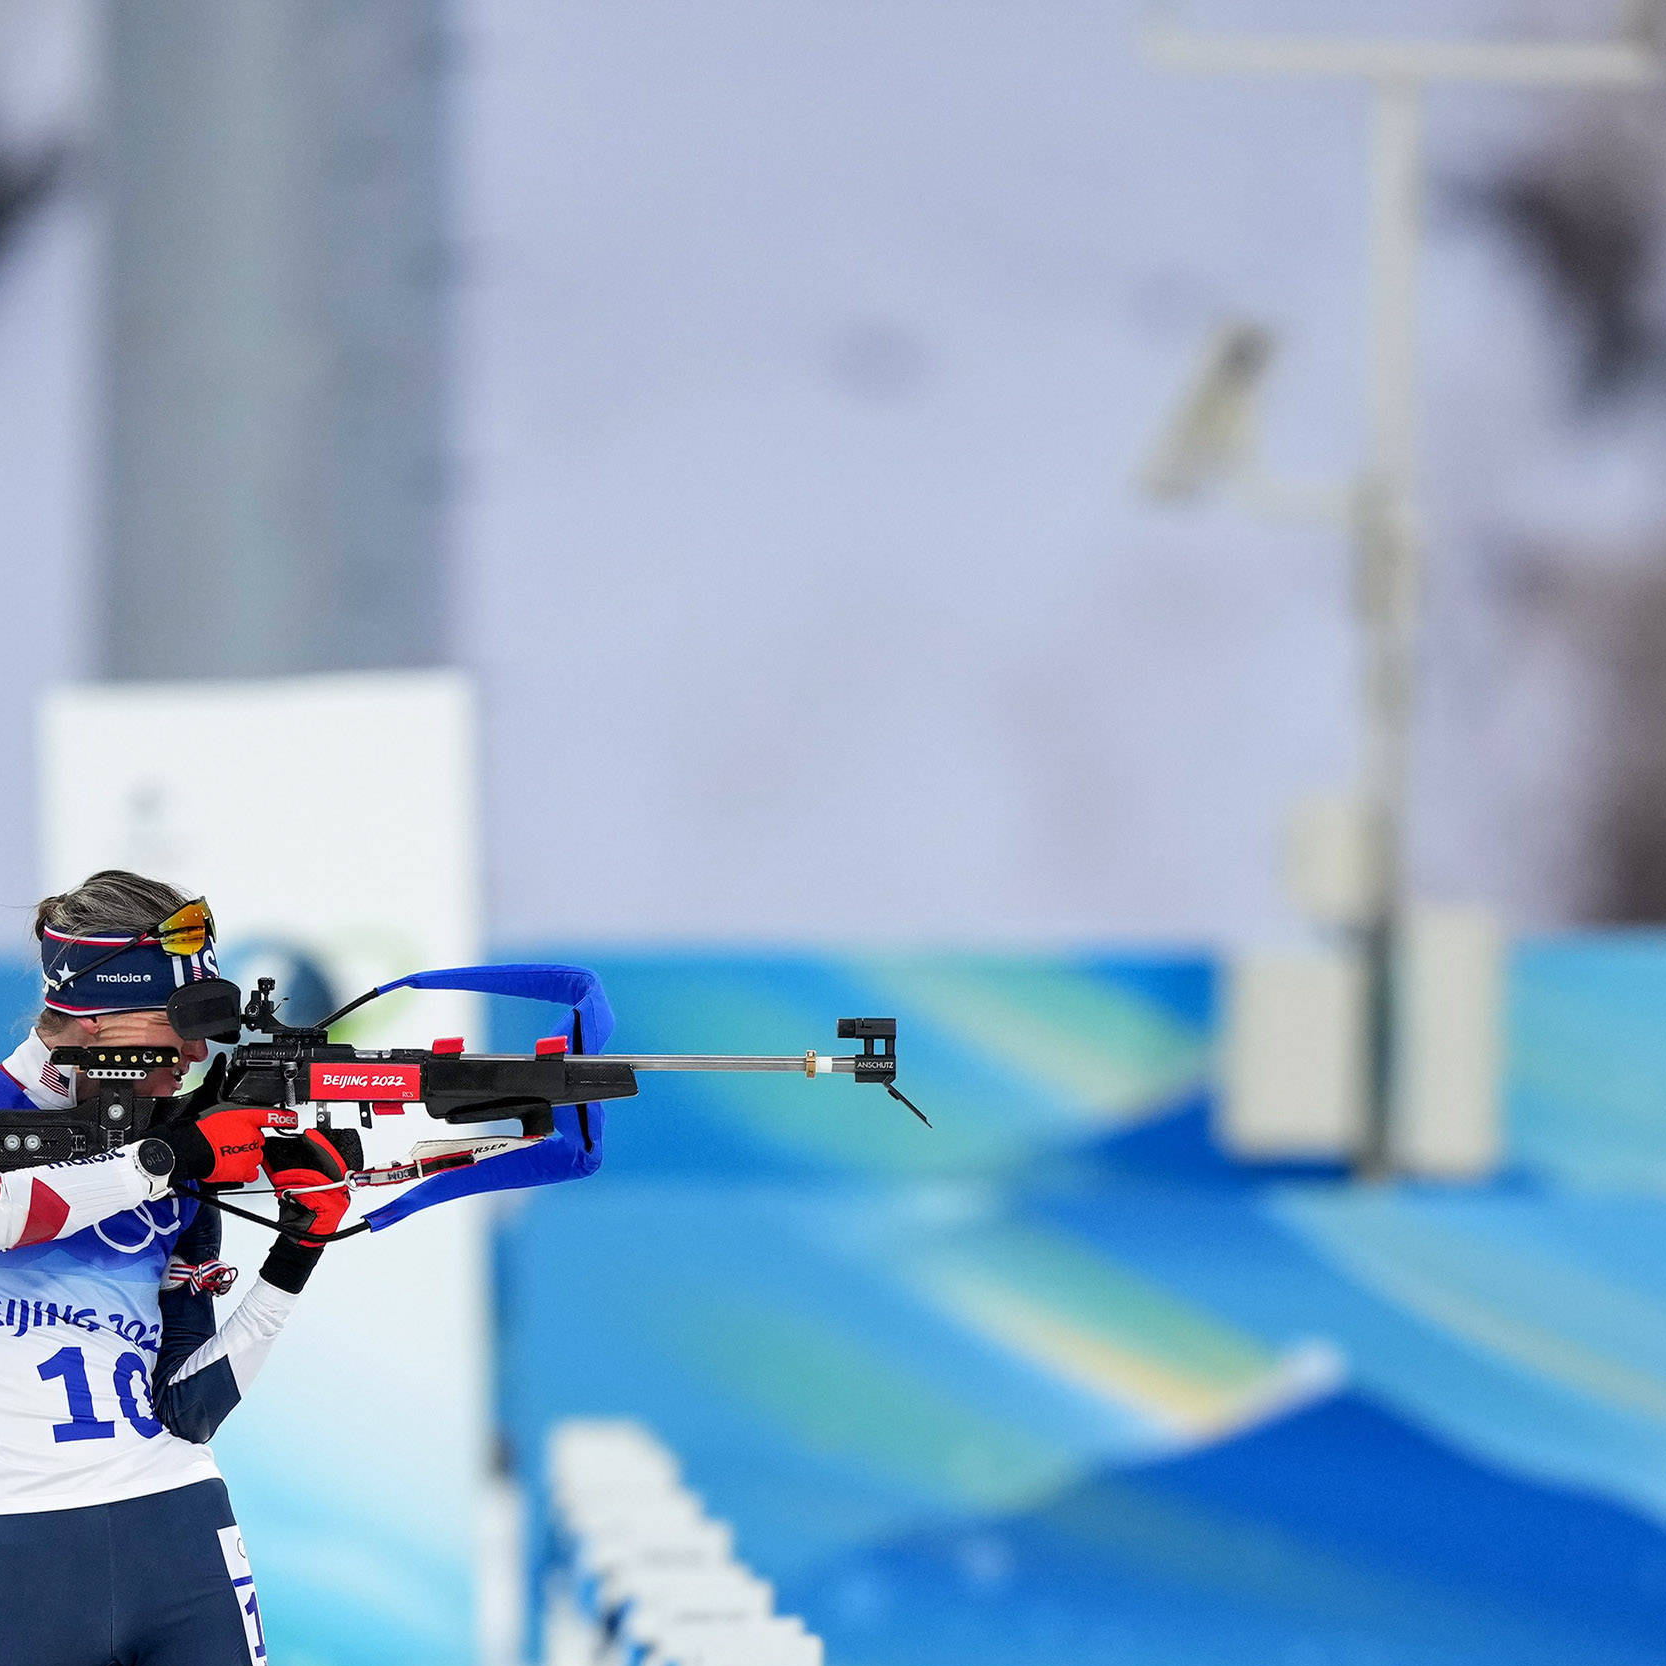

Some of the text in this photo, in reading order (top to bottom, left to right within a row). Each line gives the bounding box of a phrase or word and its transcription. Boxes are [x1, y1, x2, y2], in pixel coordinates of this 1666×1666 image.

[96, 973, 141, 983] maloja
[322, 1074, 406, 1089] BEIJING 2022
[36, 1346, 164, 1443] 10
